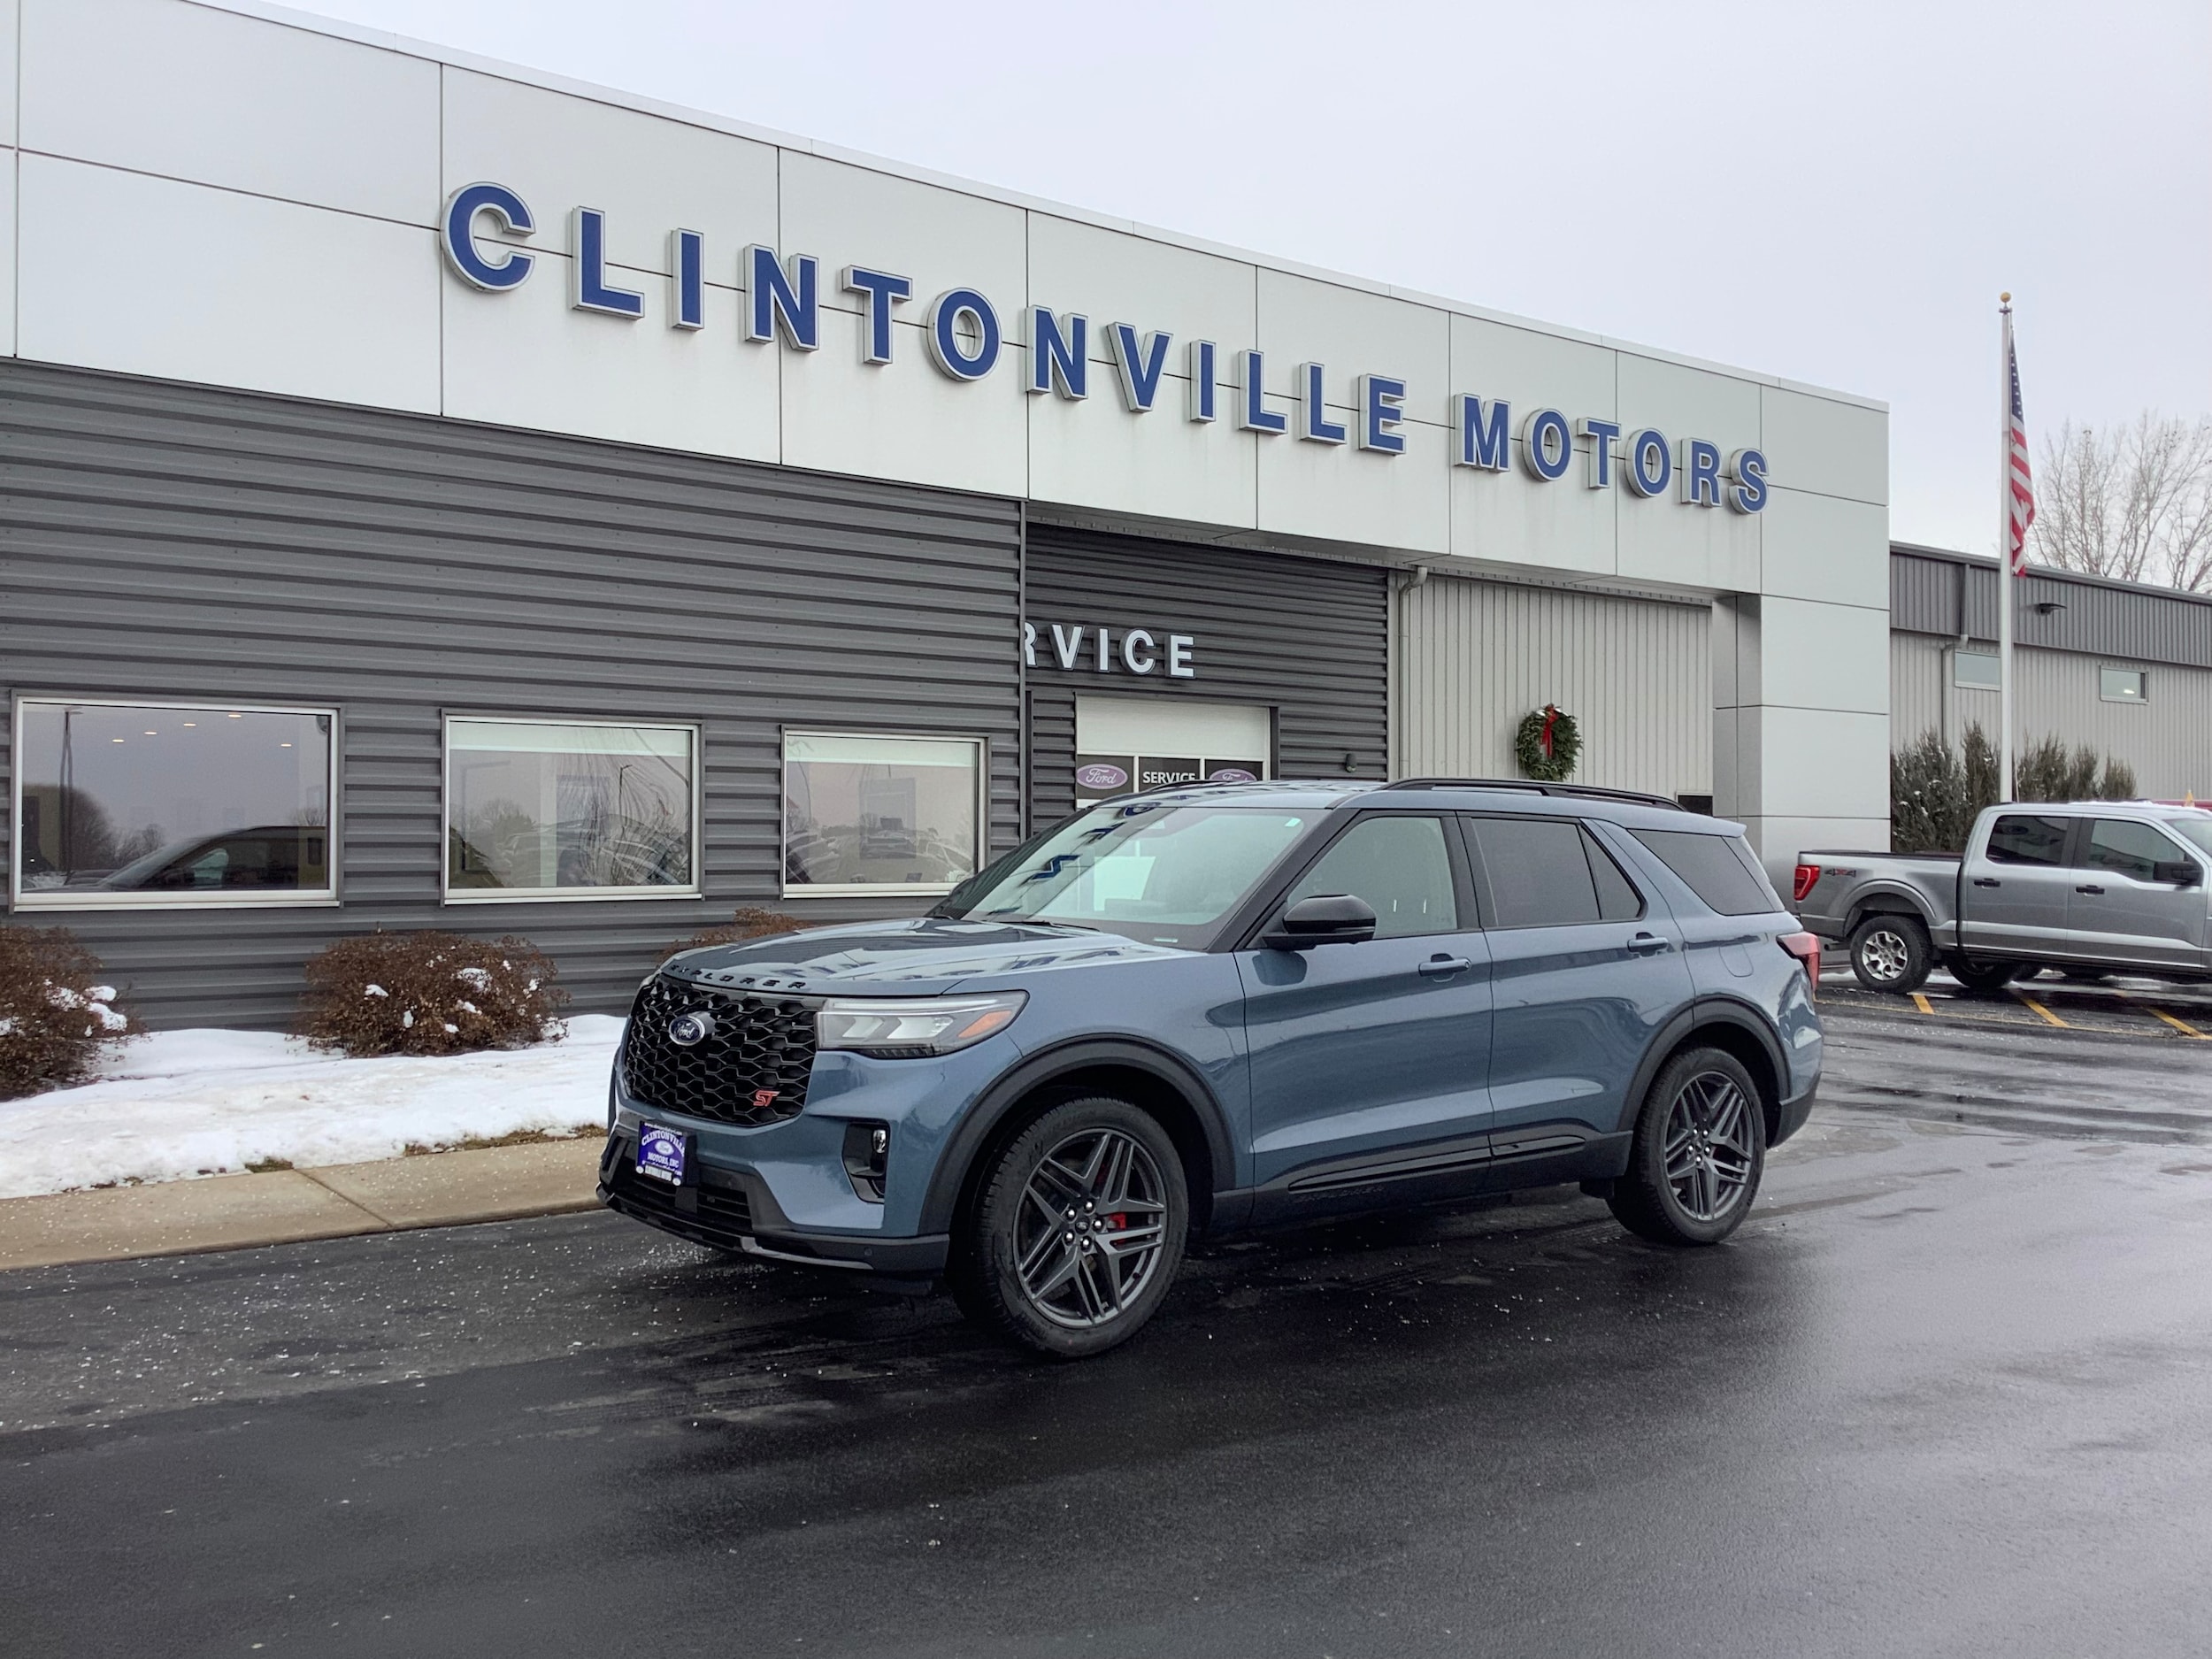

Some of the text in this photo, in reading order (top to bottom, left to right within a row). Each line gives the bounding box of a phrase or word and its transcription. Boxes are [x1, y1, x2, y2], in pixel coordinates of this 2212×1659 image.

[442, 181, 1769, 514] CLINTONVILLE MOTORS
[1085, 767, 1117, 785] Ford
[1142, 771, 1196, 784] SERVICE
[753, 1089, 780, 1107] ST
